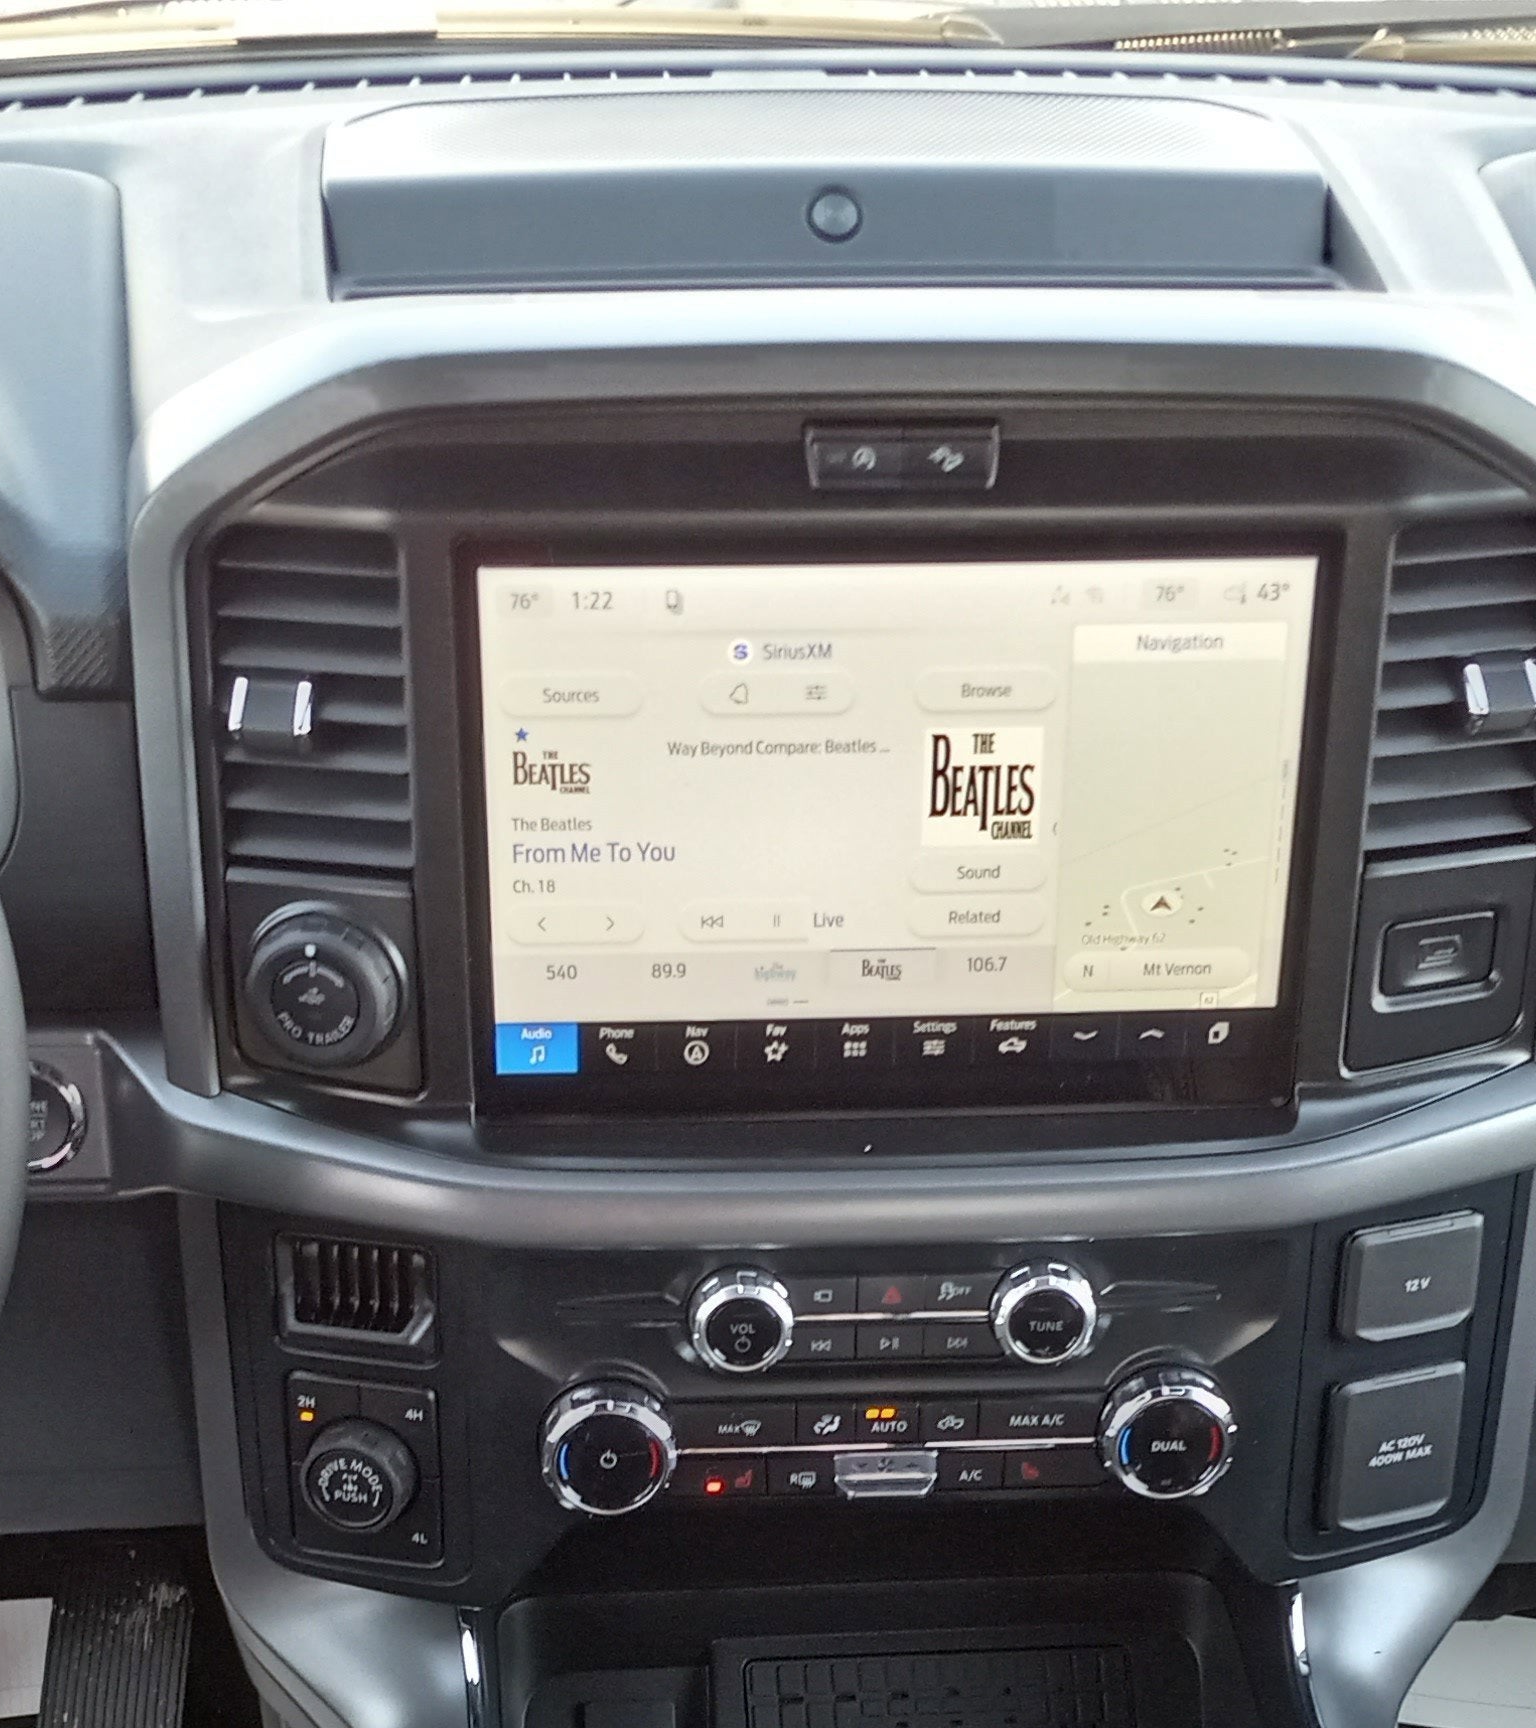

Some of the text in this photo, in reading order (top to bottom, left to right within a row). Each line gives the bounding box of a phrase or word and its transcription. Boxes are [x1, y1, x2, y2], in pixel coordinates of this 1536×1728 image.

[572, 591, 613, 610] 1:22
[1136, 634, 1223, 653] Navigation
[763, 642, 833, 661] SiriusXM
[542, 687, 599, 704] Sources
[961, 684, 1012, 699] Browse
[667, 741, 698, 757] Way
[700, 741, 753, 757] Beyond
[824, 739, 876, 755] Beatles
[973, 733, 995, 754] THE
[542, 750, 559, 761] THE
[512, 751, 592, 792] BEATLES
[928, 734, 1035, 832] BEATLES
[512, 817, 592, 832] The Beatles
[991, 820, 1033, 840] CHANNEL
[512, 842, 676, 864] From Me To You
[957, 865, 1001, 880] Sound
[512, 879, 556, 894] Ch. 18
[813, 912, 844, 928] Live
[948, 909, 1001, 925] Related
[546, 964, 578, 981] 540
[651, 963, 686, 979] 89.9
[966, 957, 1008, 973] 106.7
[1082, 964, 1094, 977] N
[1143, 962, 1211, 976] Mt Vernon
[685, 1026, 708, 1038] Nav
[766, 1024, 787, 1037] Fav
[841, 1022, 870, 1037] Apps
[913, 1020, 957, 1036] Settings
[989, 1018, 1037, 1032] Features
[520, 1027, 552, 1040] Audio
[599, 1027, 634, 1040] Phone
[729, 1323, 756, 1335] VOL
[1028, 1319, 1064, 1333] TUNE
[297, 1394, 315, 1409] 2H
[404, 1408, 424, 1422] 4H
[1009, 1413, 1065, 1428] MAX A/C
[718, 1423, 740, 1436] MAX
[871, 1420, 908, 1434] AUTO
[1151, 1440, 1187, 1454] DUAL
[1378, 1433, 1427, 1454] AC 120V
[1368, 1444, 1433, 1469] 400W MAX
[318, 1457, 384, 1494] DRIVE MODE
[959, 1468, 984, 1482] A/C
[334, 1488, 368, 1504] PUSH
[411, 1531, 429, 1546] 4L
